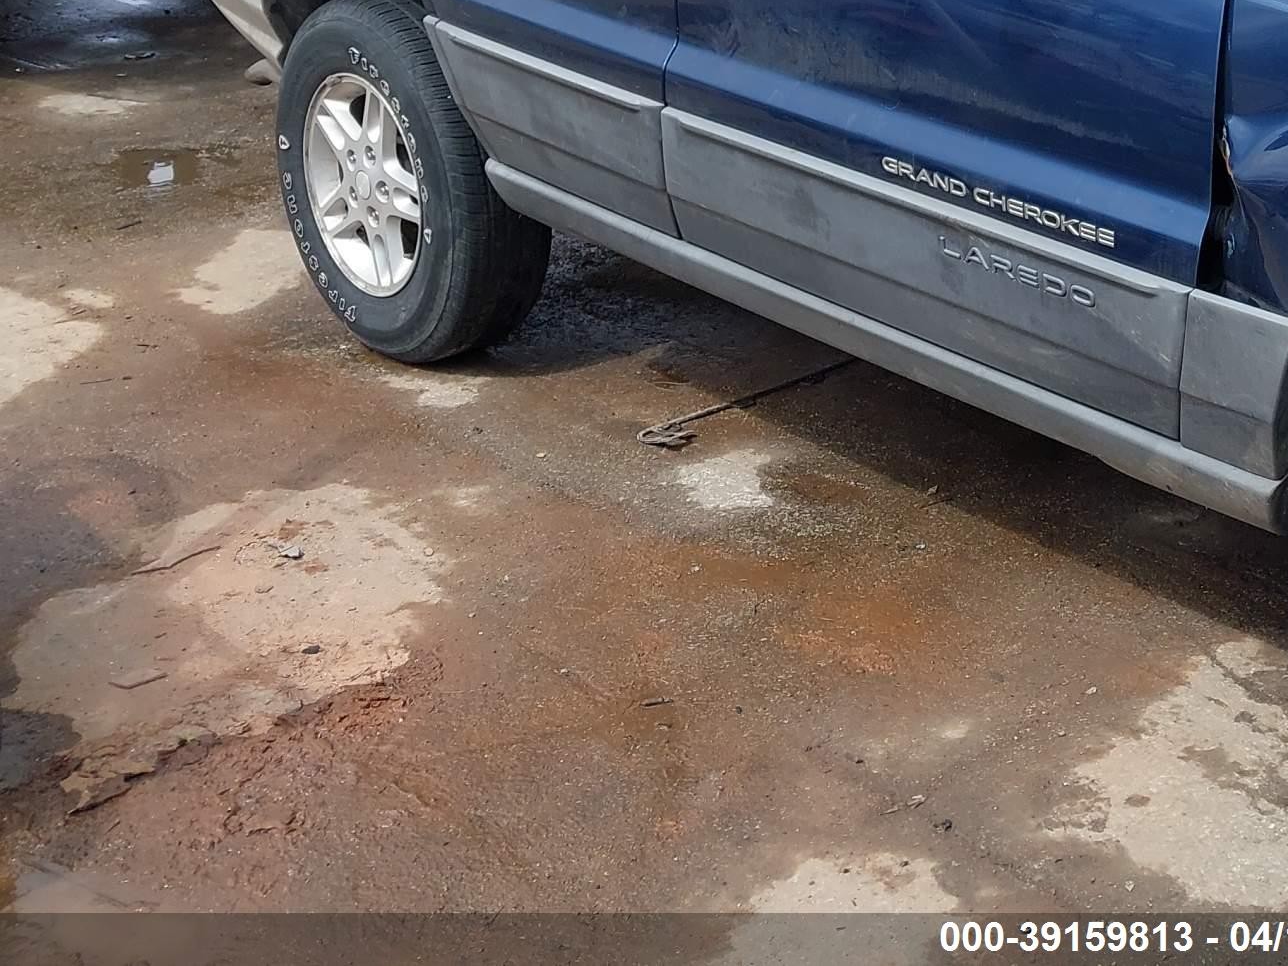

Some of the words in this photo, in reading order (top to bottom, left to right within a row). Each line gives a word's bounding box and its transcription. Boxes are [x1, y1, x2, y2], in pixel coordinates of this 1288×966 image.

[348, 46, 430, 205] Firestone
[282, 171, 357, 323] Firestone
[881, 156, 967, 197] GRAND
[973, 187, 1115, 248] CHEROKEE
[938, 235, 1096, 308] LAREDO
